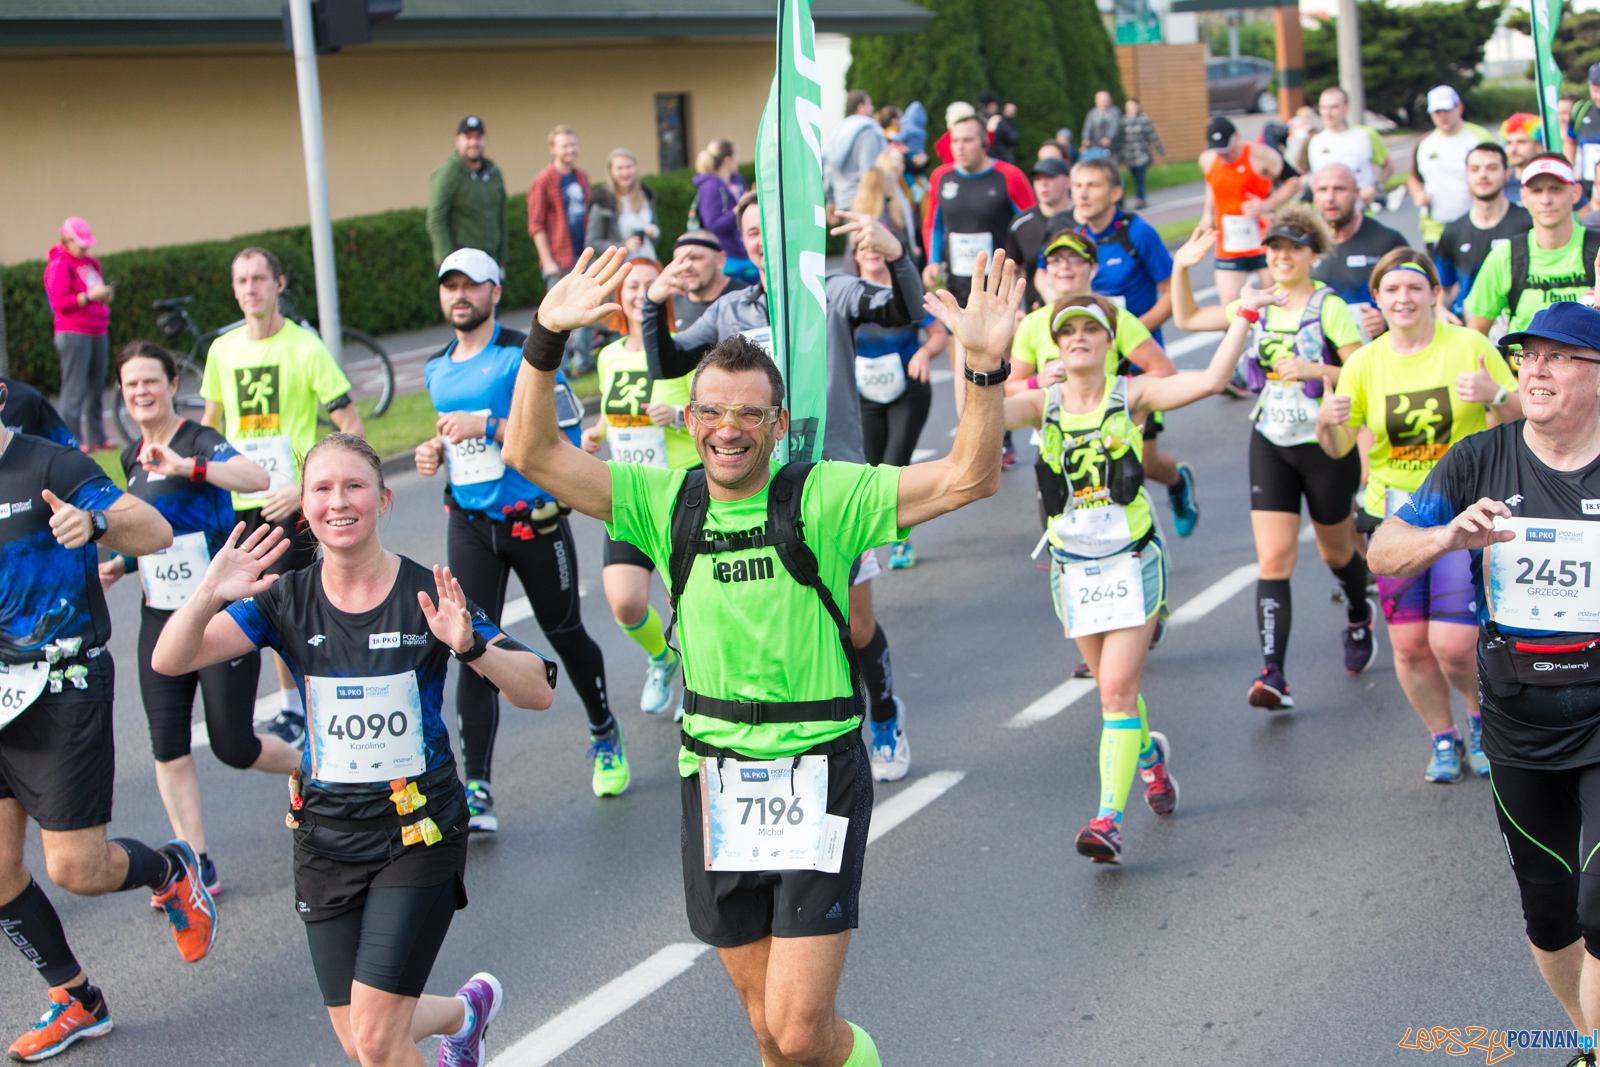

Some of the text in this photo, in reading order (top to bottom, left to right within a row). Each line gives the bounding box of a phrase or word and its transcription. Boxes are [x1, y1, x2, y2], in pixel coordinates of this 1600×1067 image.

[1270, 408, 1308, 423] 5038
[1538, 531, 1555, 540] PKO
[155, 561, 192, 581] 465
[553, 540, 570, 591] DOBSOM
[1515, 557, 1592, 588] 2451
[1079, 580, 1129, 604] 2645
[1527, 587, 1579, 598] GRZEGORZ
[382, 636, 398, 644] PKO
[347, 688, 362, 696] PKO
[327, 711, 408, 741] 4090
[350, 742, 386, 751] Karolina
[751, 771, 767, 779] PKO
[736, 796, 804, 826] 7196
[758, 828, 785, 837] Michał
